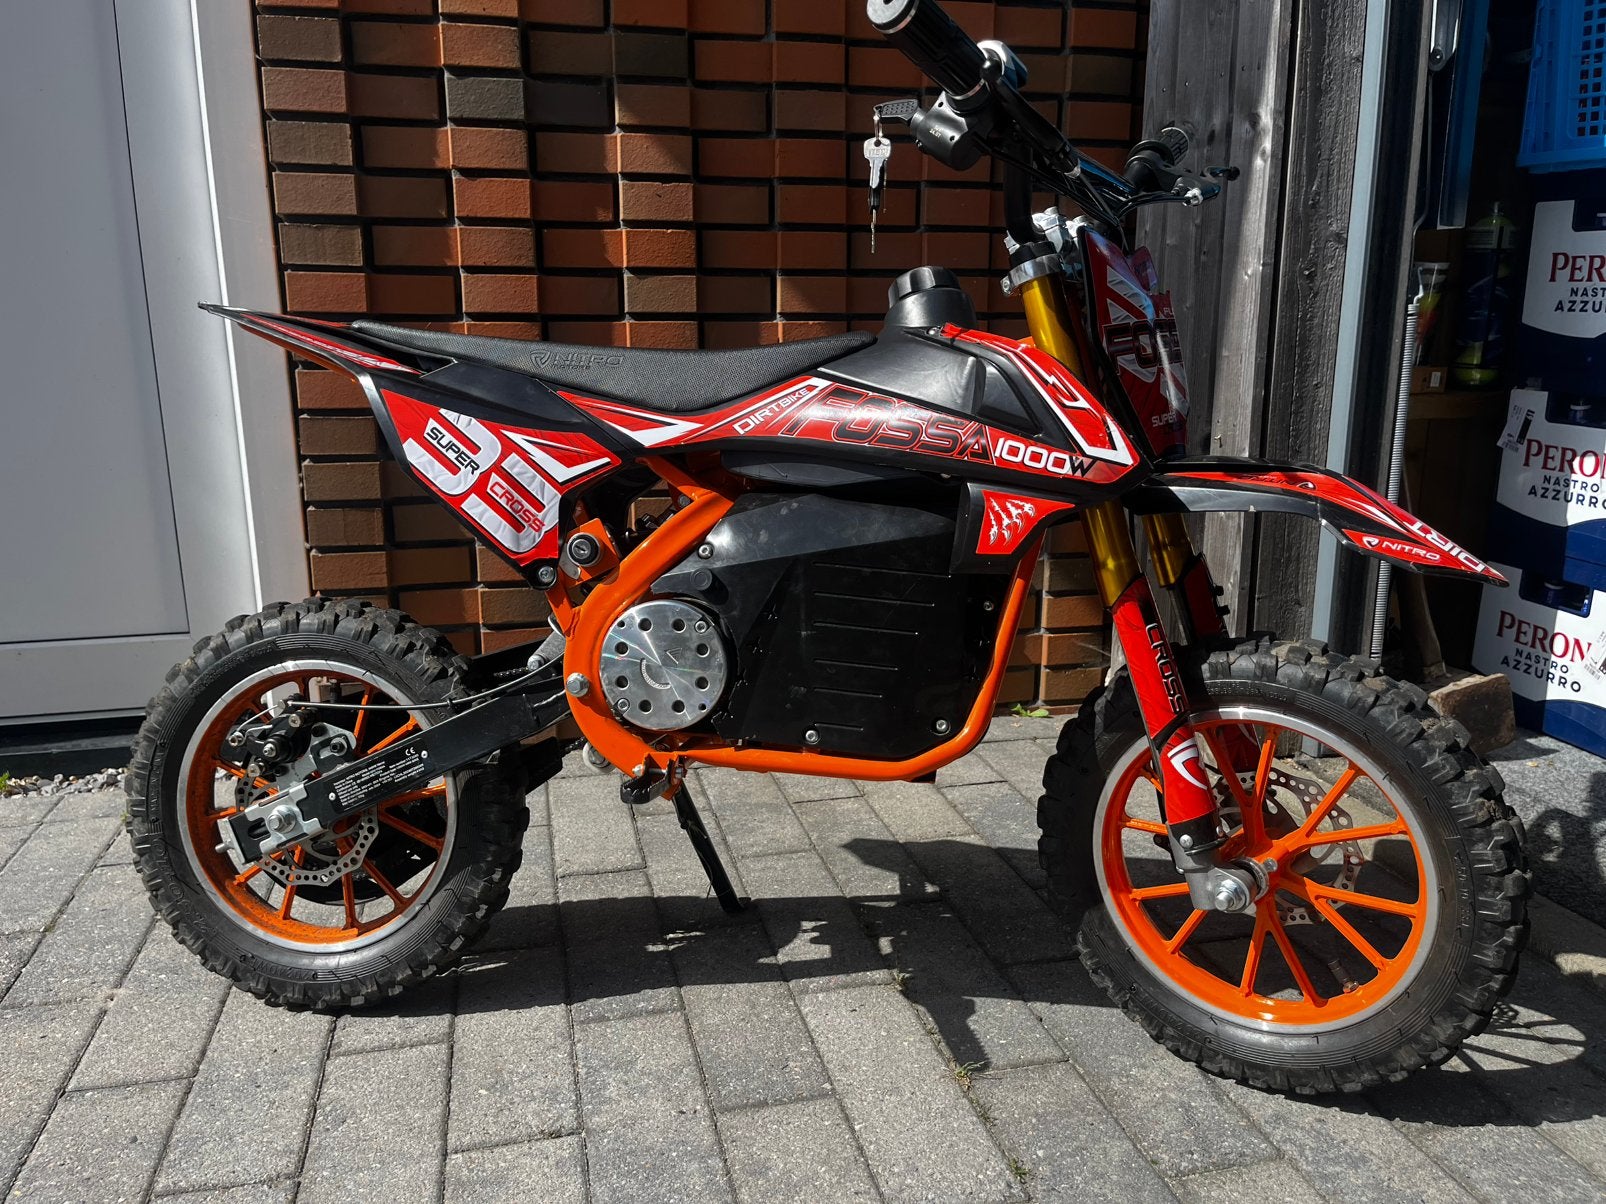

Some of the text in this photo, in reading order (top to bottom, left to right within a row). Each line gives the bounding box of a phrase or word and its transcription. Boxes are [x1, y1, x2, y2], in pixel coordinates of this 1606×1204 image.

[1554, 300, 1606, 313] AZZU
[732, 381, 1099, 478] DIRTBIKE FOSSA 1000W
[425, 425, 480, 476] SUPER
[1542, 474, 1601, 493] NASTRO
[488, 480, 546, 535] CROSS
[1382, 541, 1442, 562] NITRO
[1145, 622, 1185, 715] CROSS
[1500, 656, 1582, 693] AZZURRO
[1515, 648, 1569, 674] NASTRO
